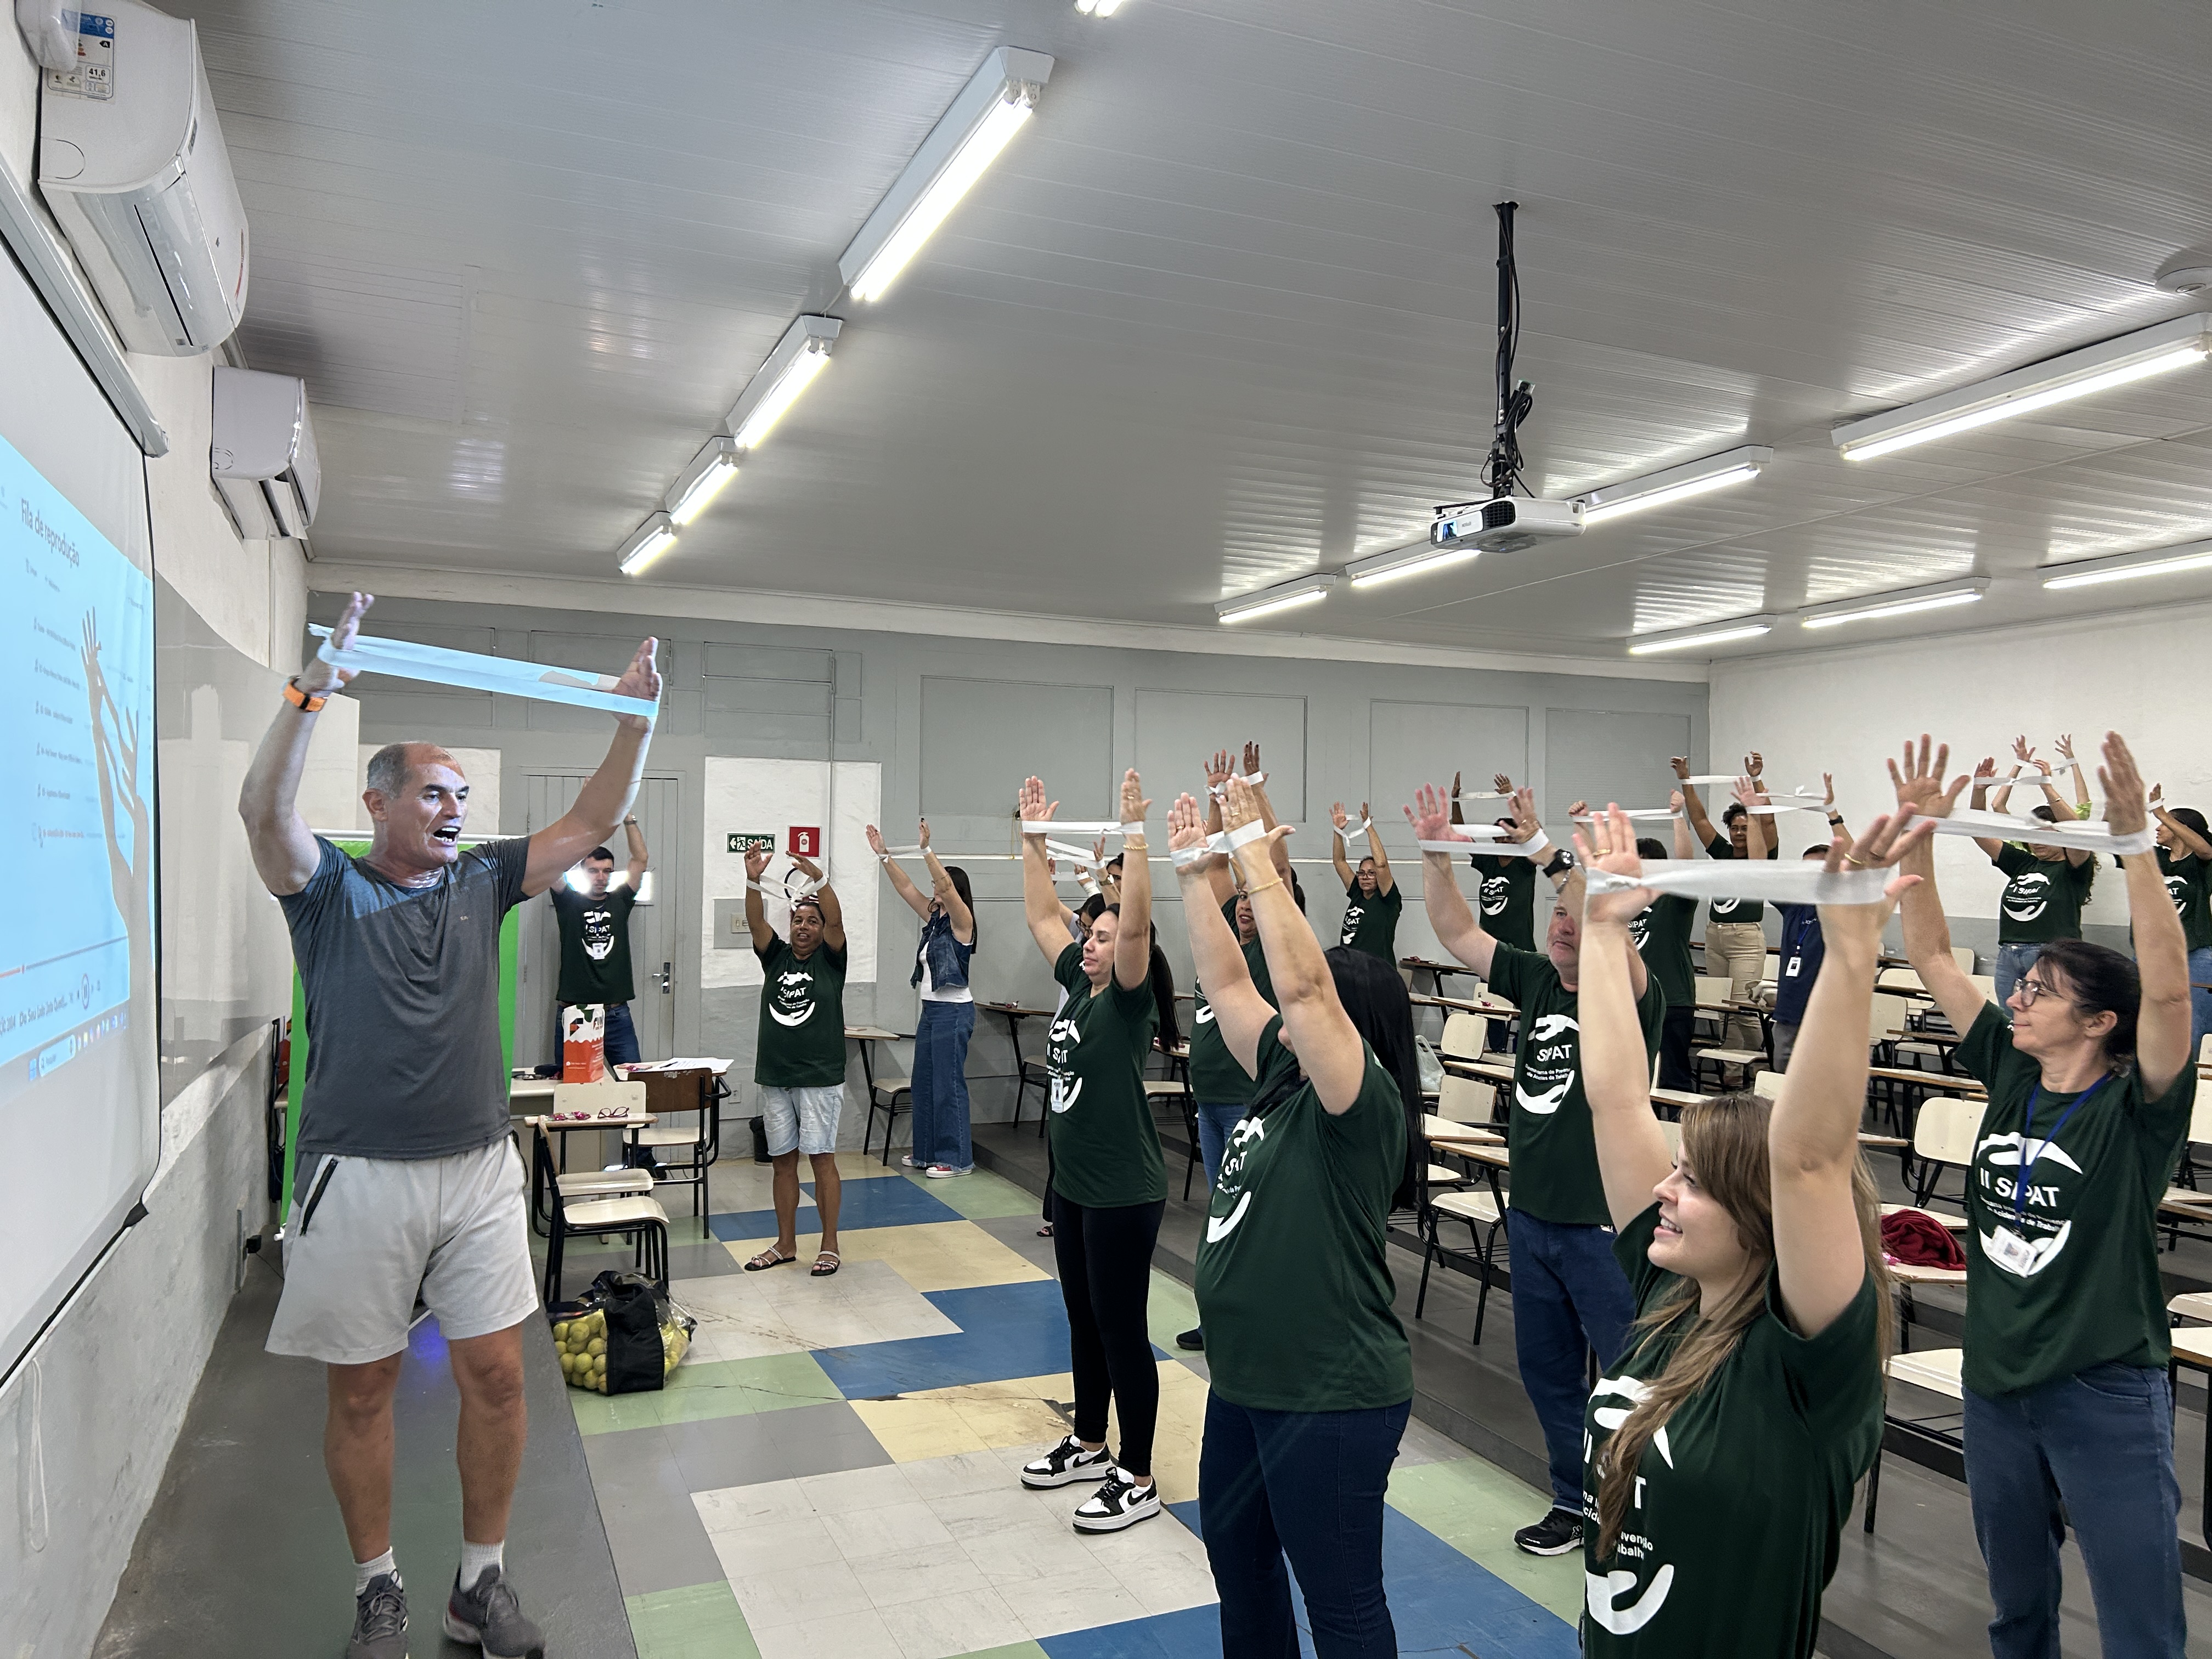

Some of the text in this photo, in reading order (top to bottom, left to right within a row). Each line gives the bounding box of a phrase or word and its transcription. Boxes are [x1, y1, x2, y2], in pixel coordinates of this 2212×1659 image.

[89, 68, 106, 77] 41,6
[21, 498, 33, 531] Fila
[35, 509, 44, 538] de
[44, 522, 80, 569] reprodução
[1980, 1167, 1990, 1189] II
